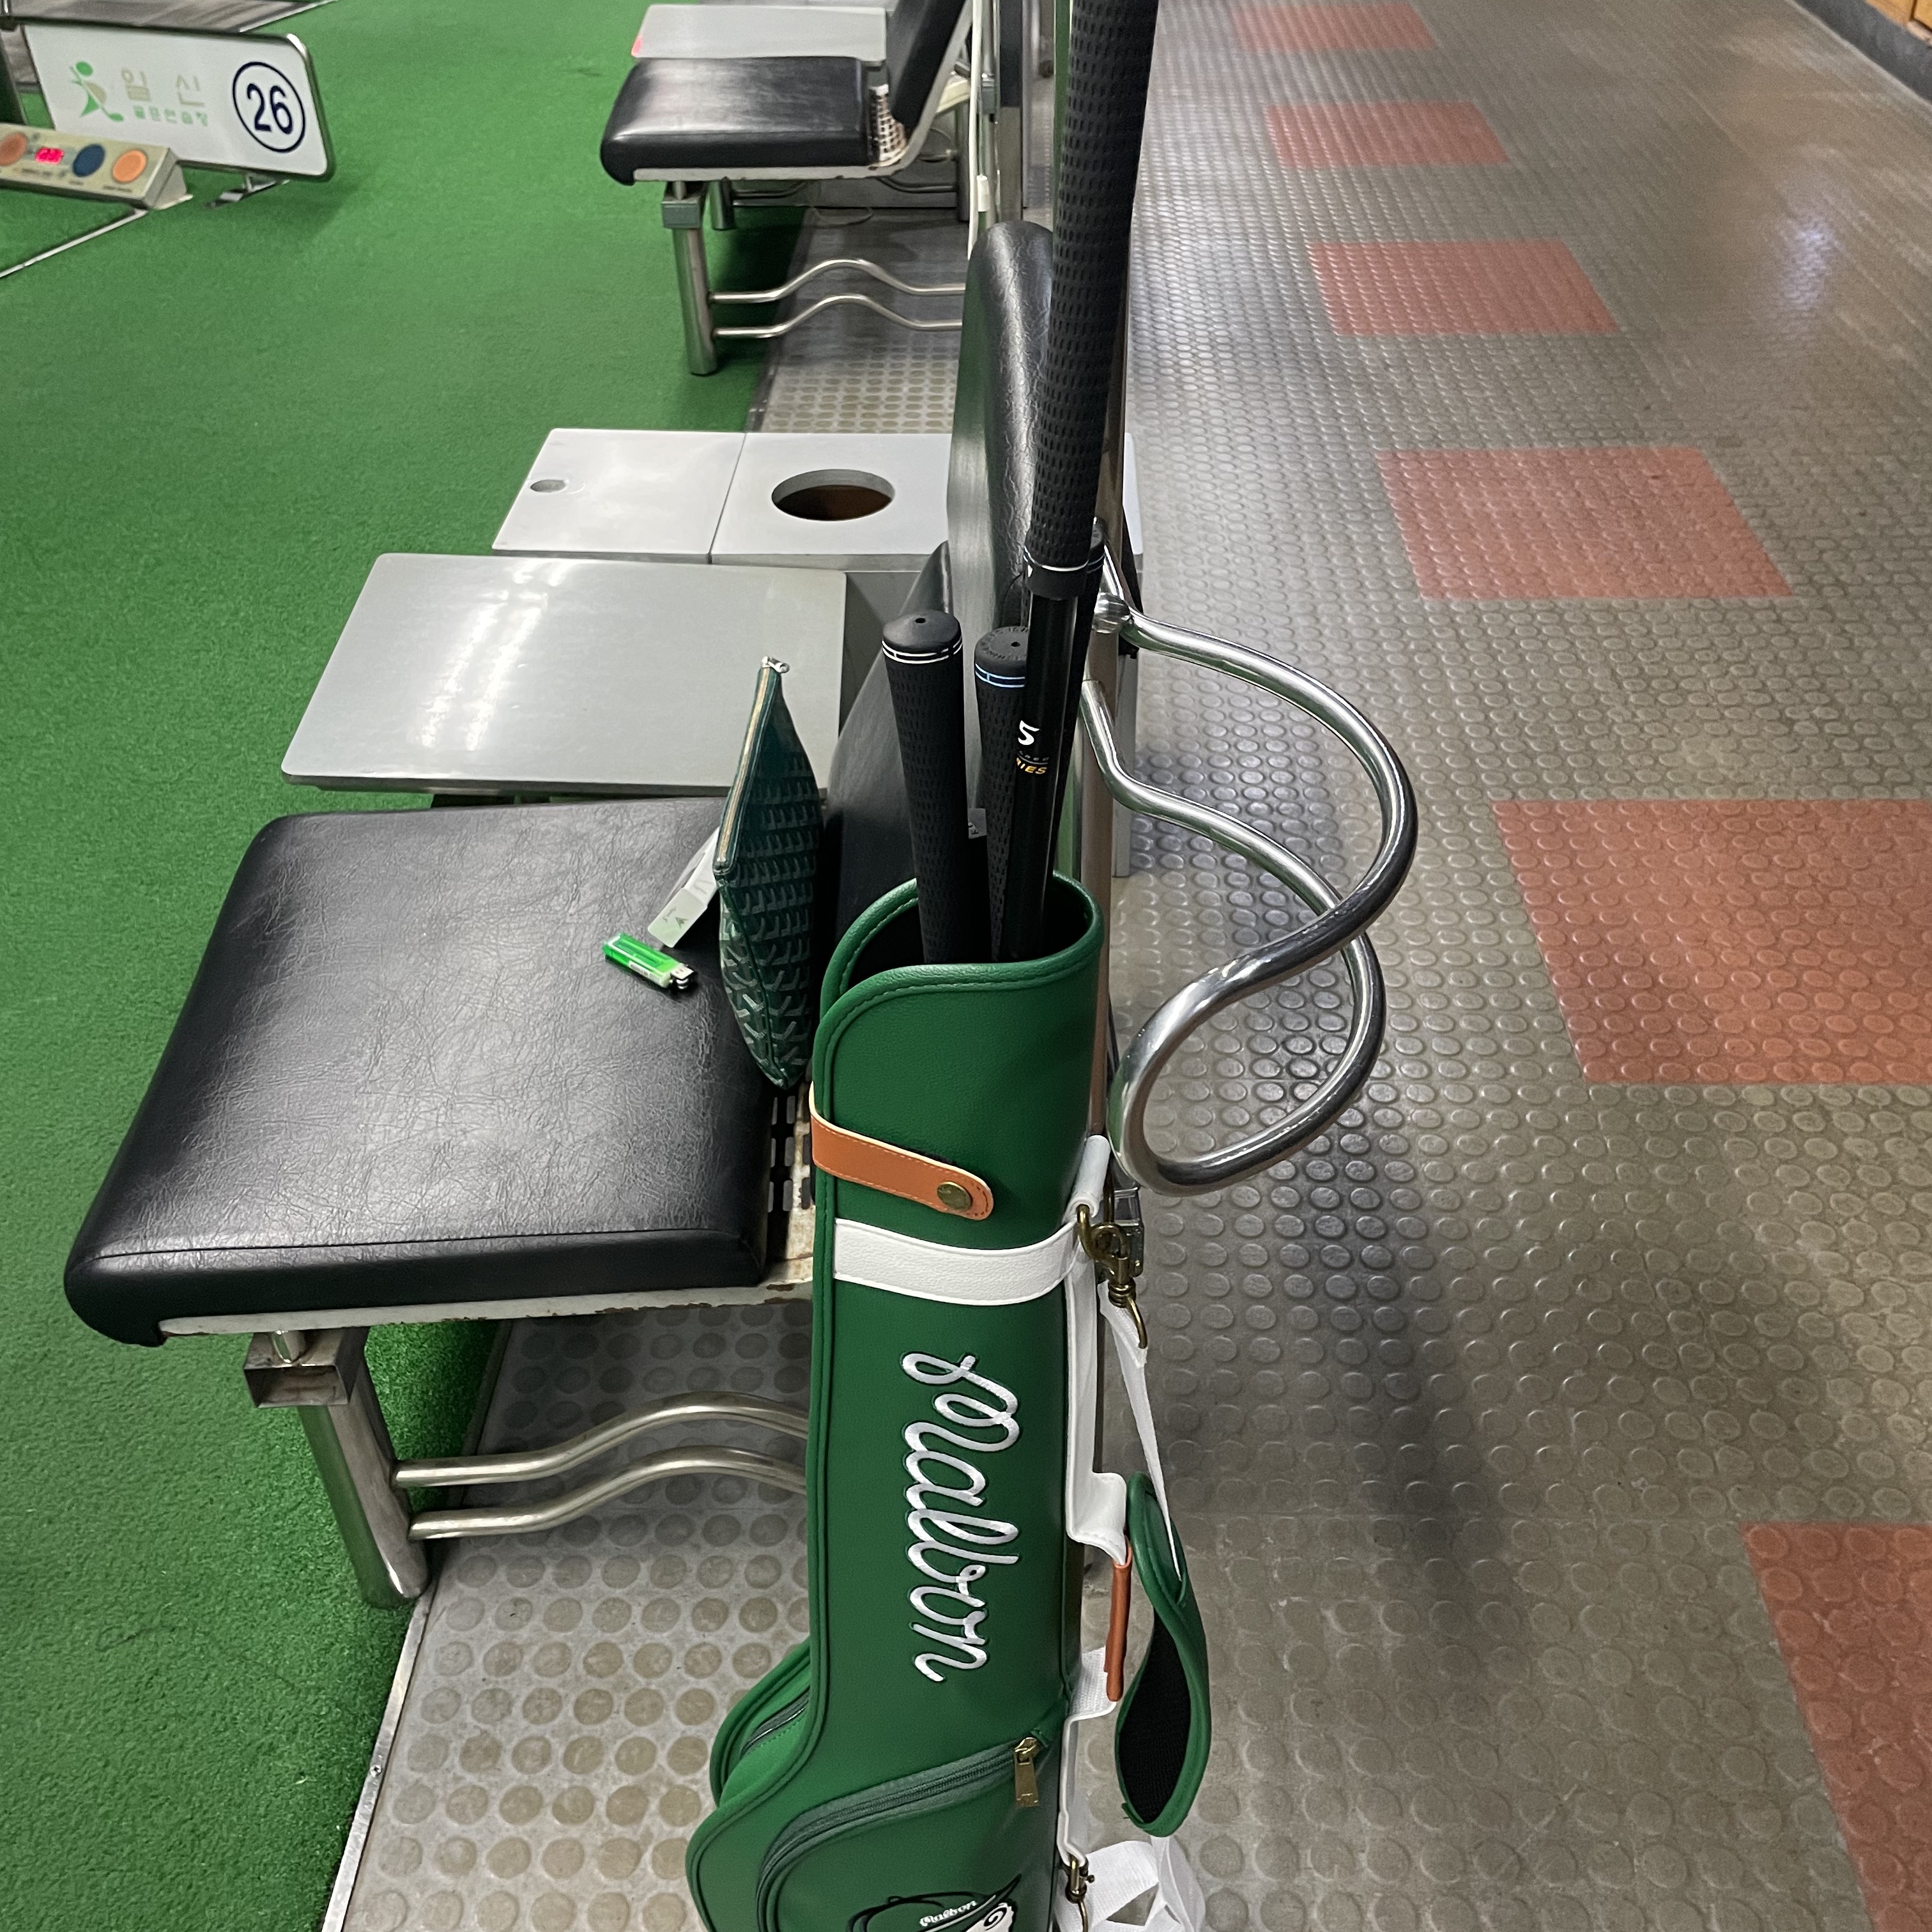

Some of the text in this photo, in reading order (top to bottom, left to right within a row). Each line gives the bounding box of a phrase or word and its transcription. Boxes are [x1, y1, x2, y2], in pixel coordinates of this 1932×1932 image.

[247, 83, 293, 135] 26
[901, 1353, 1020, 1682] Malbon
[919, 1900, 977, 1927] Malbon
